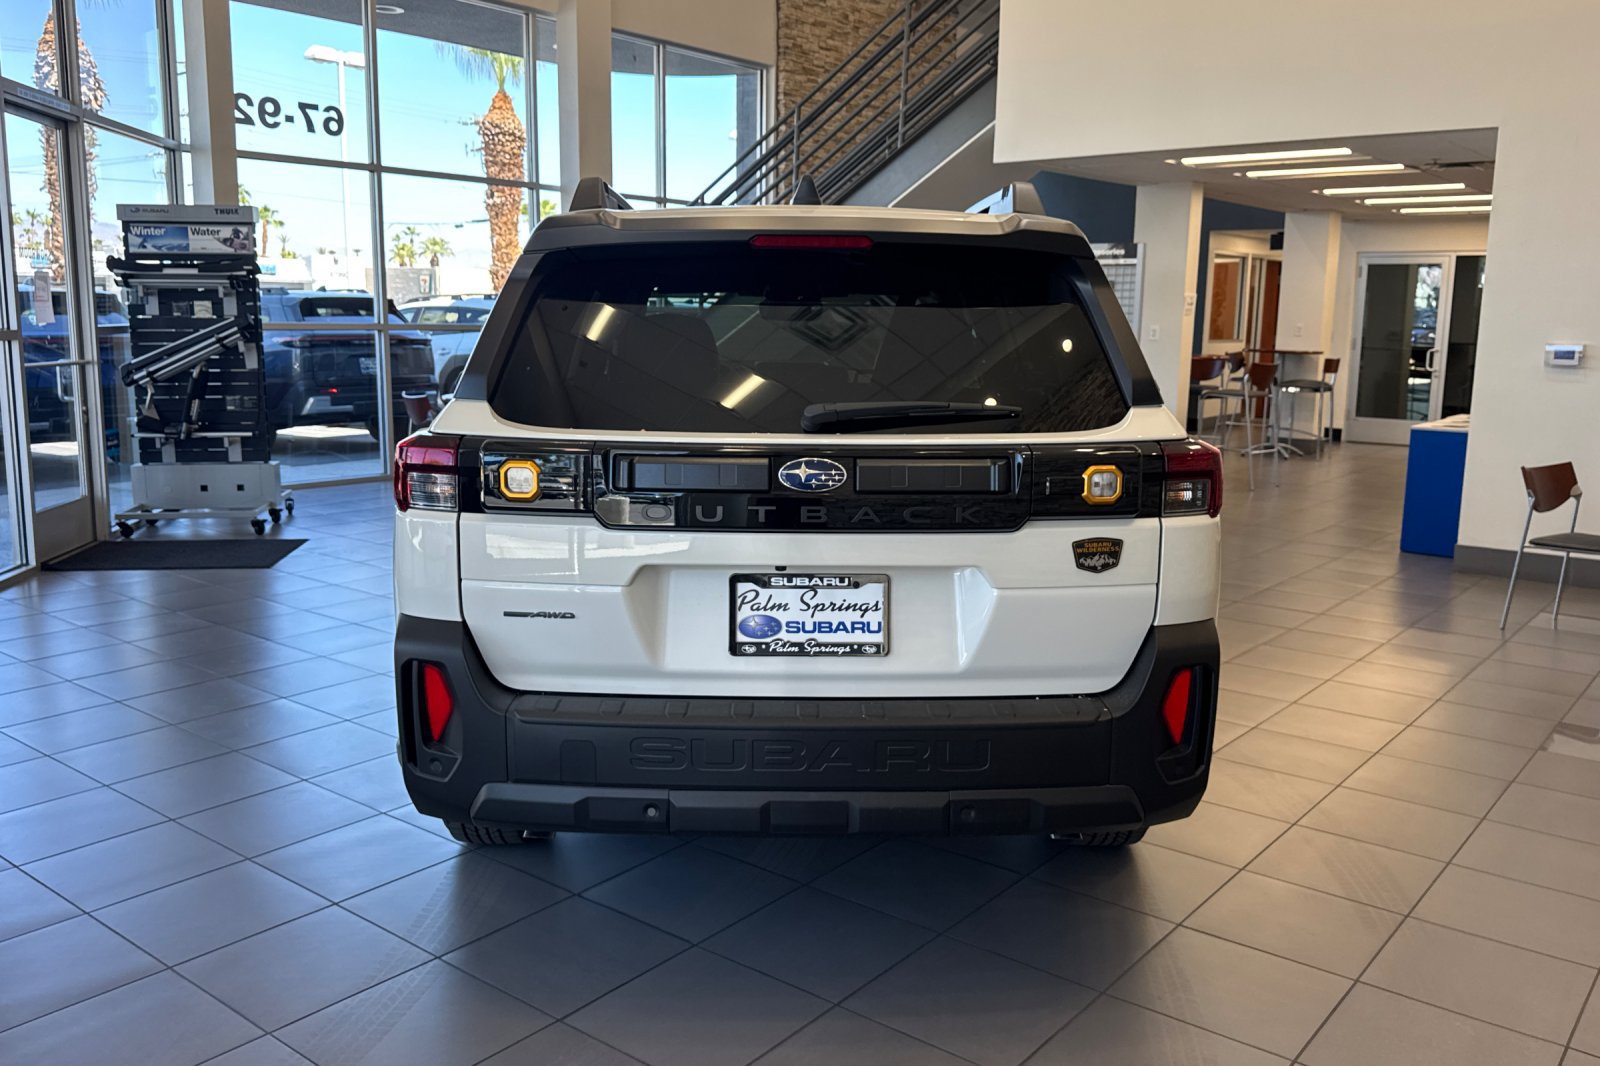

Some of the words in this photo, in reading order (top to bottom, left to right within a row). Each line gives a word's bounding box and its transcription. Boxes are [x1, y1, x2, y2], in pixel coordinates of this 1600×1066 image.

[130, 226, 166, 236] Winter
[190, 227, 221, 237] Water
[643, 502, 985, 526] OUTBACK
[770, 576, 848, 587] SUBARU
[737, 588, 790, 613] Palm
[799, 588, 881, 619] Springs
[530, 611, 576, 619] AWD
[785, 620, 882, 634] SUBARU
[768, 640, 799, 652] Palm
[803, 641, 851, 655] Springs
[628, 735, 992, 774] SUBARU
